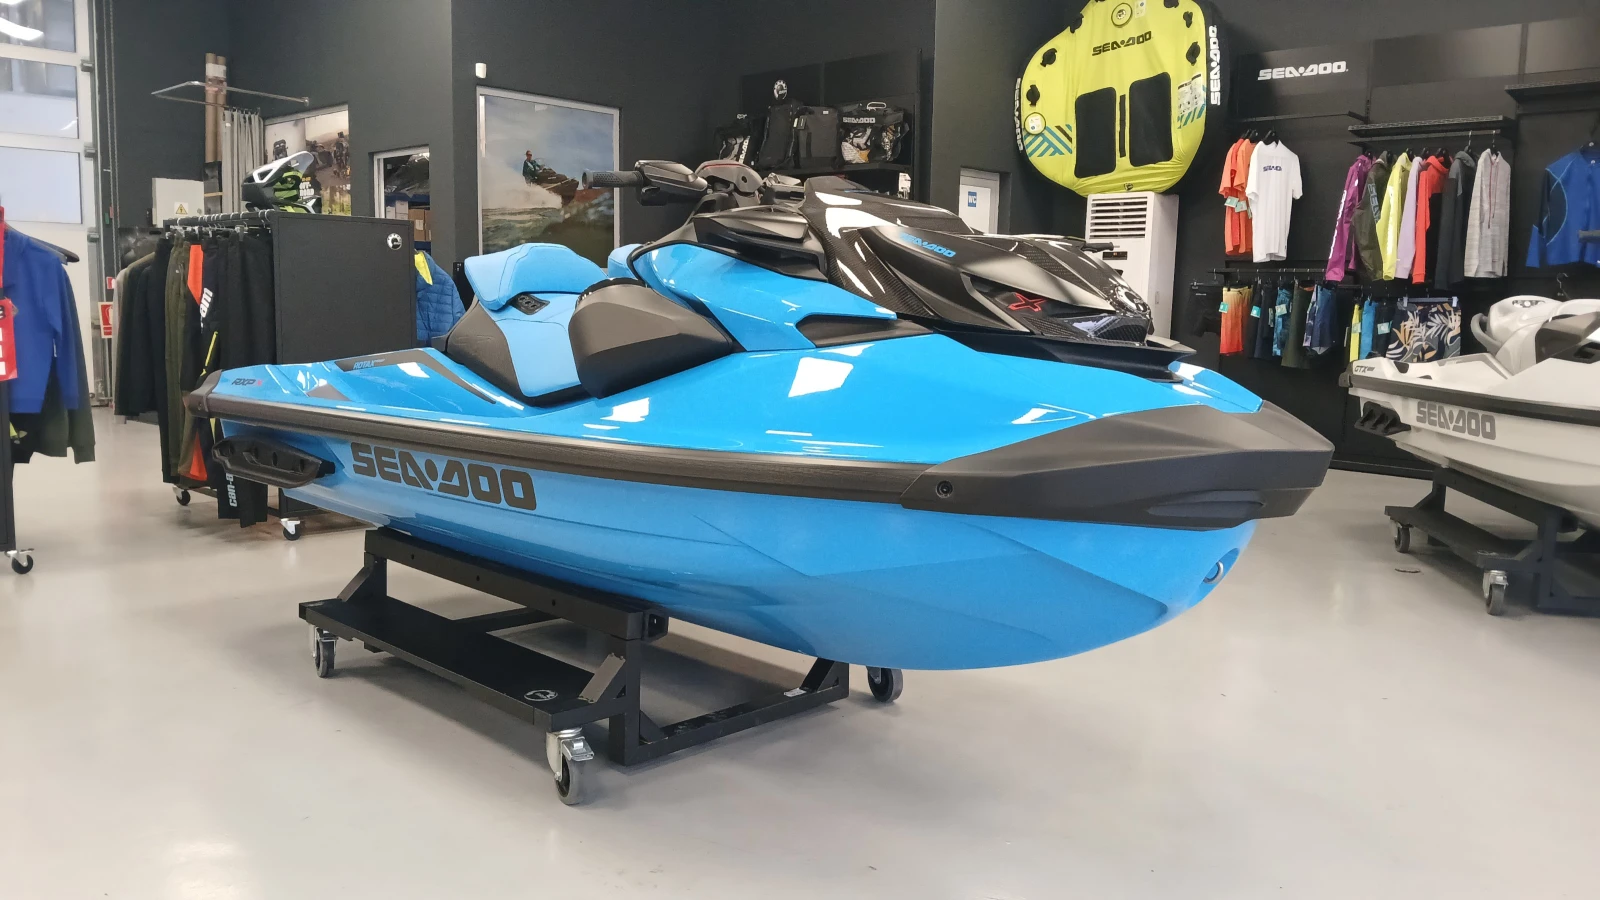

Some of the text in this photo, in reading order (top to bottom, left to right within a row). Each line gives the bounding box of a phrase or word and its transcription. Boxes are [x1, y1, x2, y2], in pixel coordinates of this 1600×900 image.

[968, 195, 977, 203] WC
[353, 360, 375, 370] ROTAX
[1354, 365, 1368, 373] GTX
[231, 378, 256, 386] RXP
